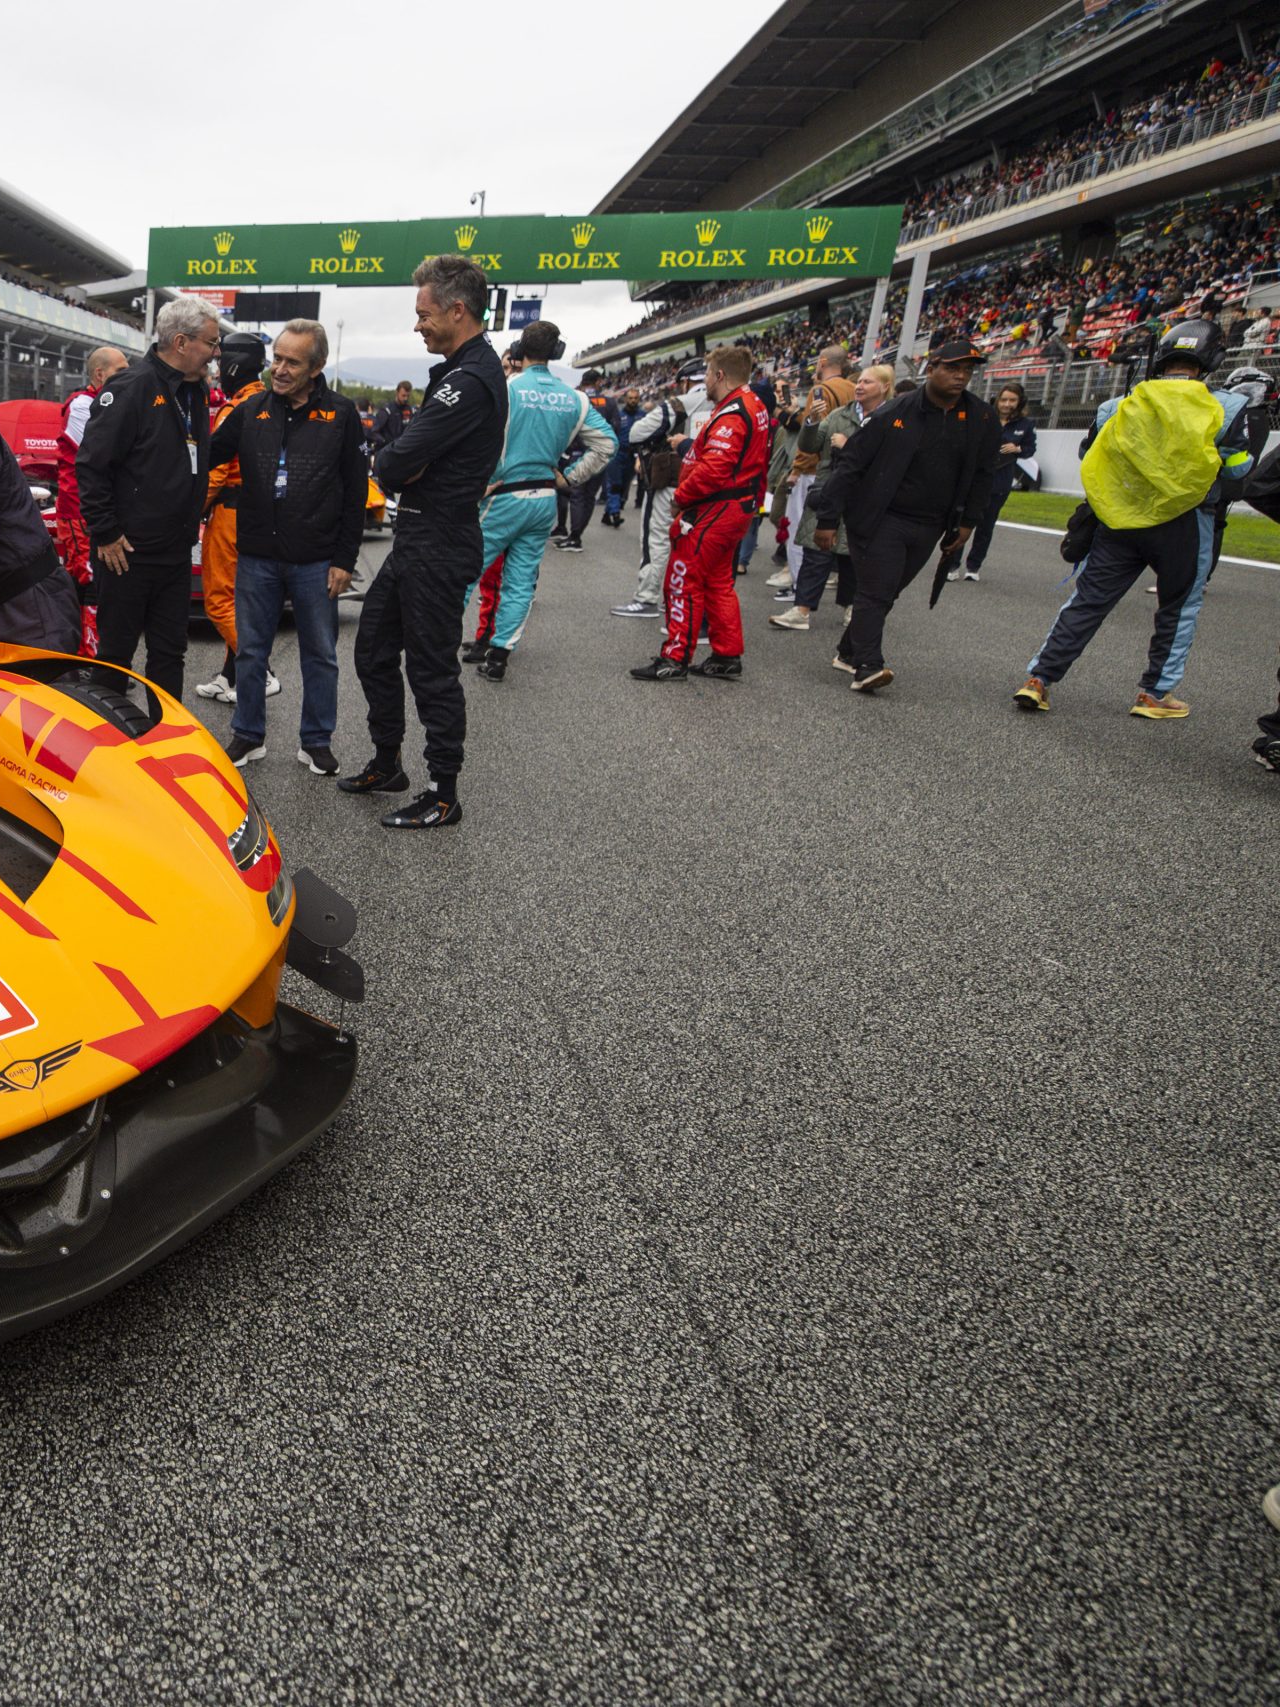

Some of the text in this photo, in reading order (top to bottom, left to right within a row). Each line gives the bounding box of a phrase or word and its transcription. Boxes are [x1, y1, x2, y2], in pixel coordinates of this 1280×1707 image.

[537, 252, 621, 270] ROLEX
[658, 249, 747, 268] ROLEX
[767, 247, 859, 266] ROLEX
[187, 259, 258, 275] ROLEX
[309, 257, 385, 274] ROLEX
[518, 389, 576, 406] TOYOTA
[24, 438, 59, 447] TOYOTA
[28, 772, 68, 801] RACING
[8, 1065, 35, 1079] GENESIS
